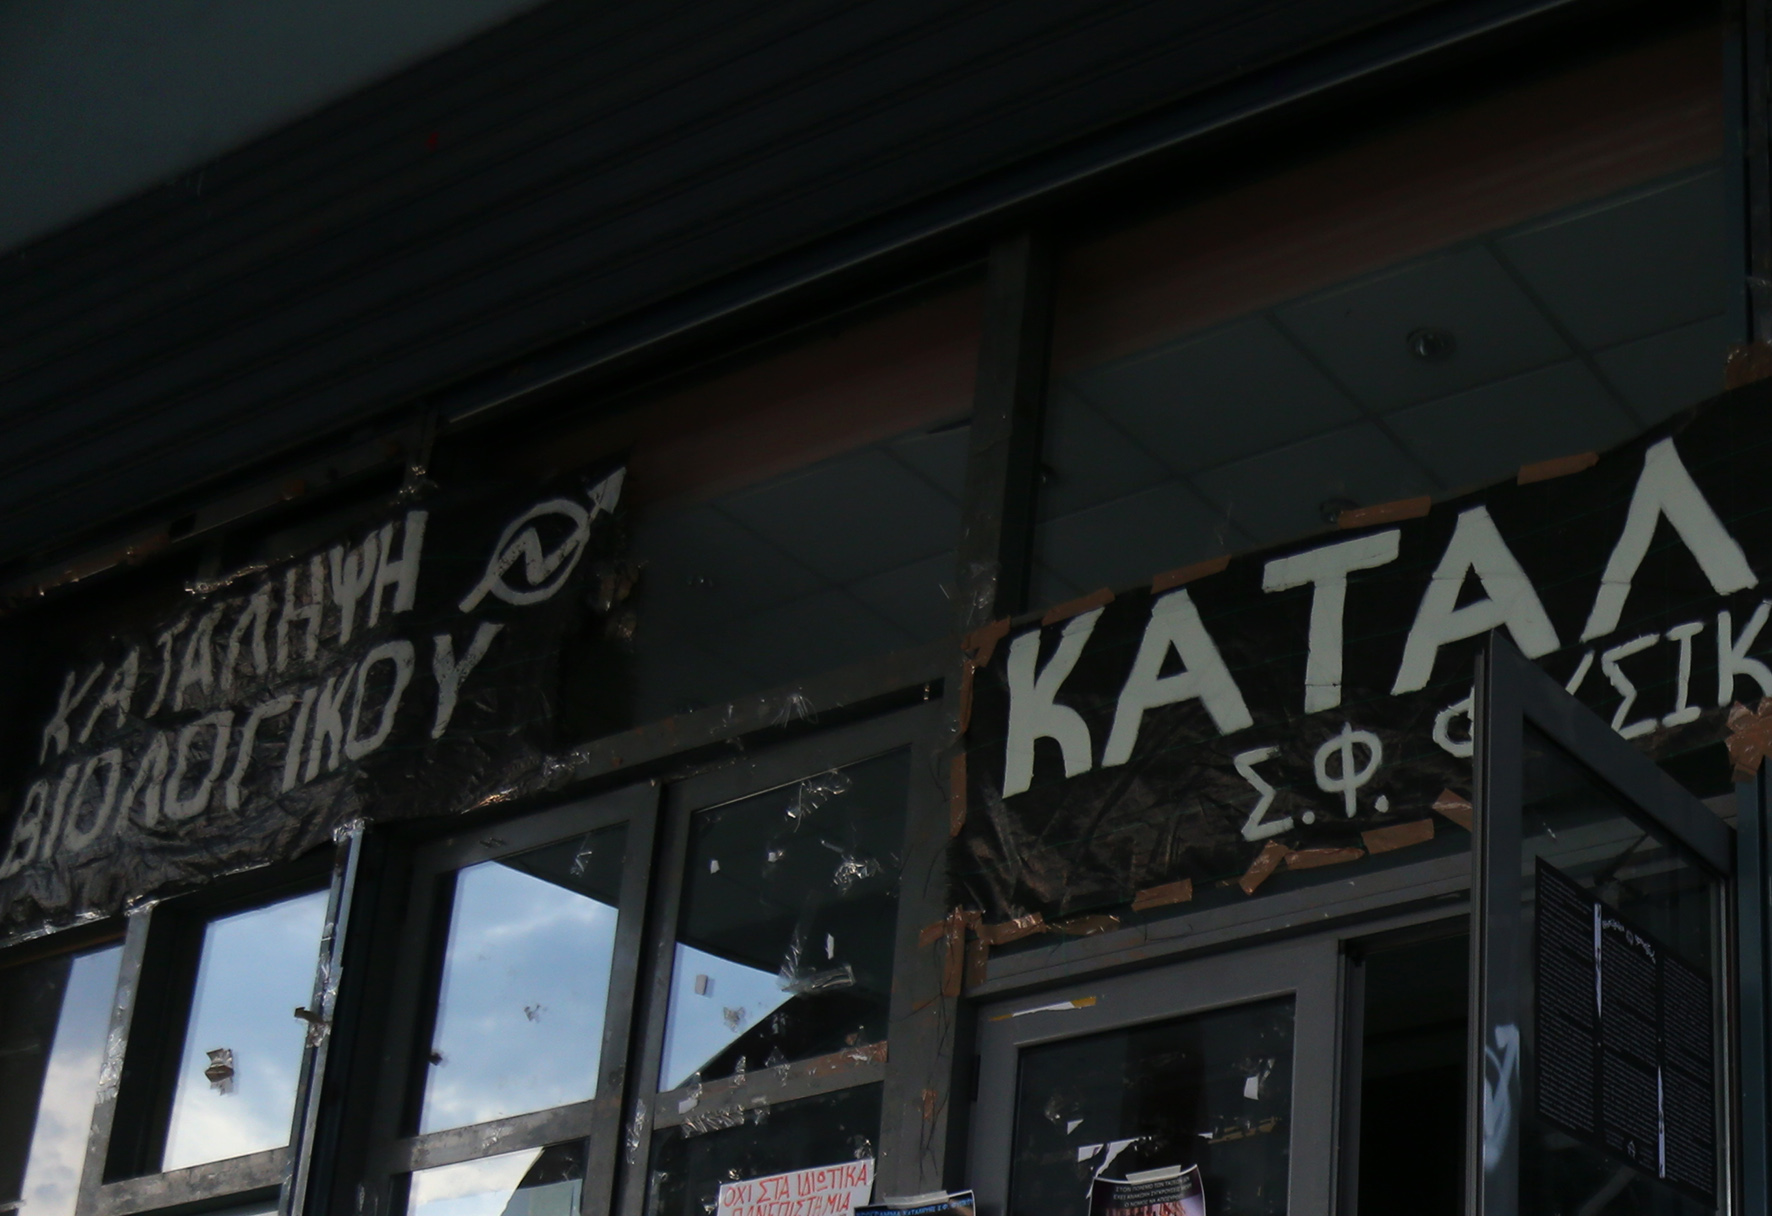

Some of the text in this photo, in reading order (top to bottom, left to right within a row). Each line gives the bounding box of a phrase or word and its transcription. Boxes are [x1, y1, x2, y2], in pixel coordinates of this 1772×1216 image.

[38, 509, 429, 766] ΚΑΤΑΛΗΨΗ
[0, 621, 504, 880] ΒΙΟΛΟΓΙΚΟΥ
[1232, 722, 1391, 842] Σ.Φ.
[723, 1163, 868, 1207] ΟΧΙ ΣΤΑ ΙΔΙΩΤΙΚΑ
